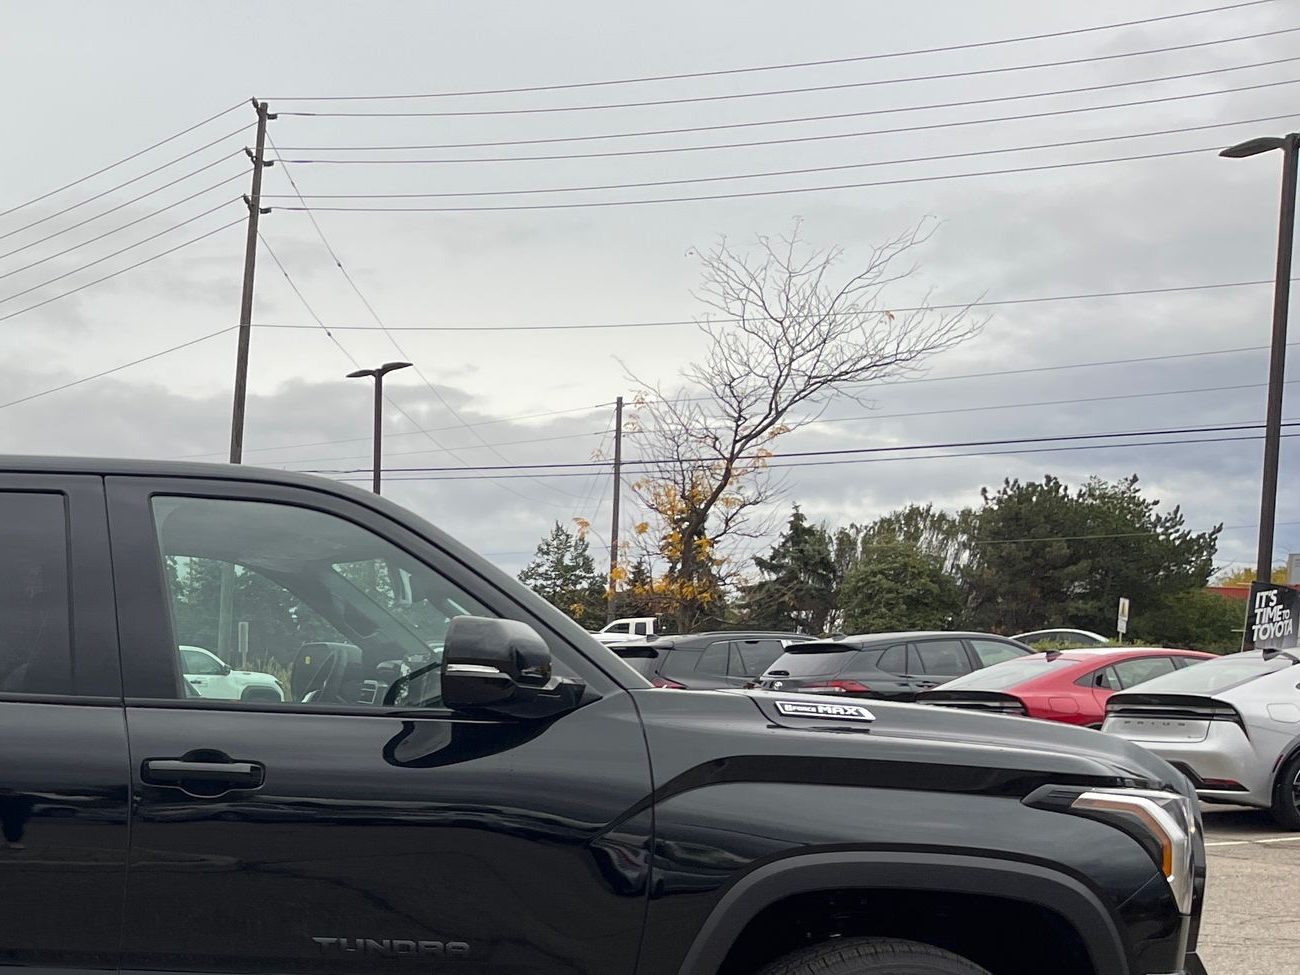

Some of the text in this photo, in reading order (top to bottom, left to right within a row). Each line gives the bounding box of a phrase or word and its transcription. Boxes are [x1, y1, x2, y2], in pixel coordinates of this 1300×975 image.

[1255, 590, 1278, 609] IT'S
[1254, 604, 1291, 625] TIME TO
[1251, 619, 1293, 642] TOYOTA
[817, 705, 859, 715] MAX
[312, 936, 470, 957] TUNDRA
